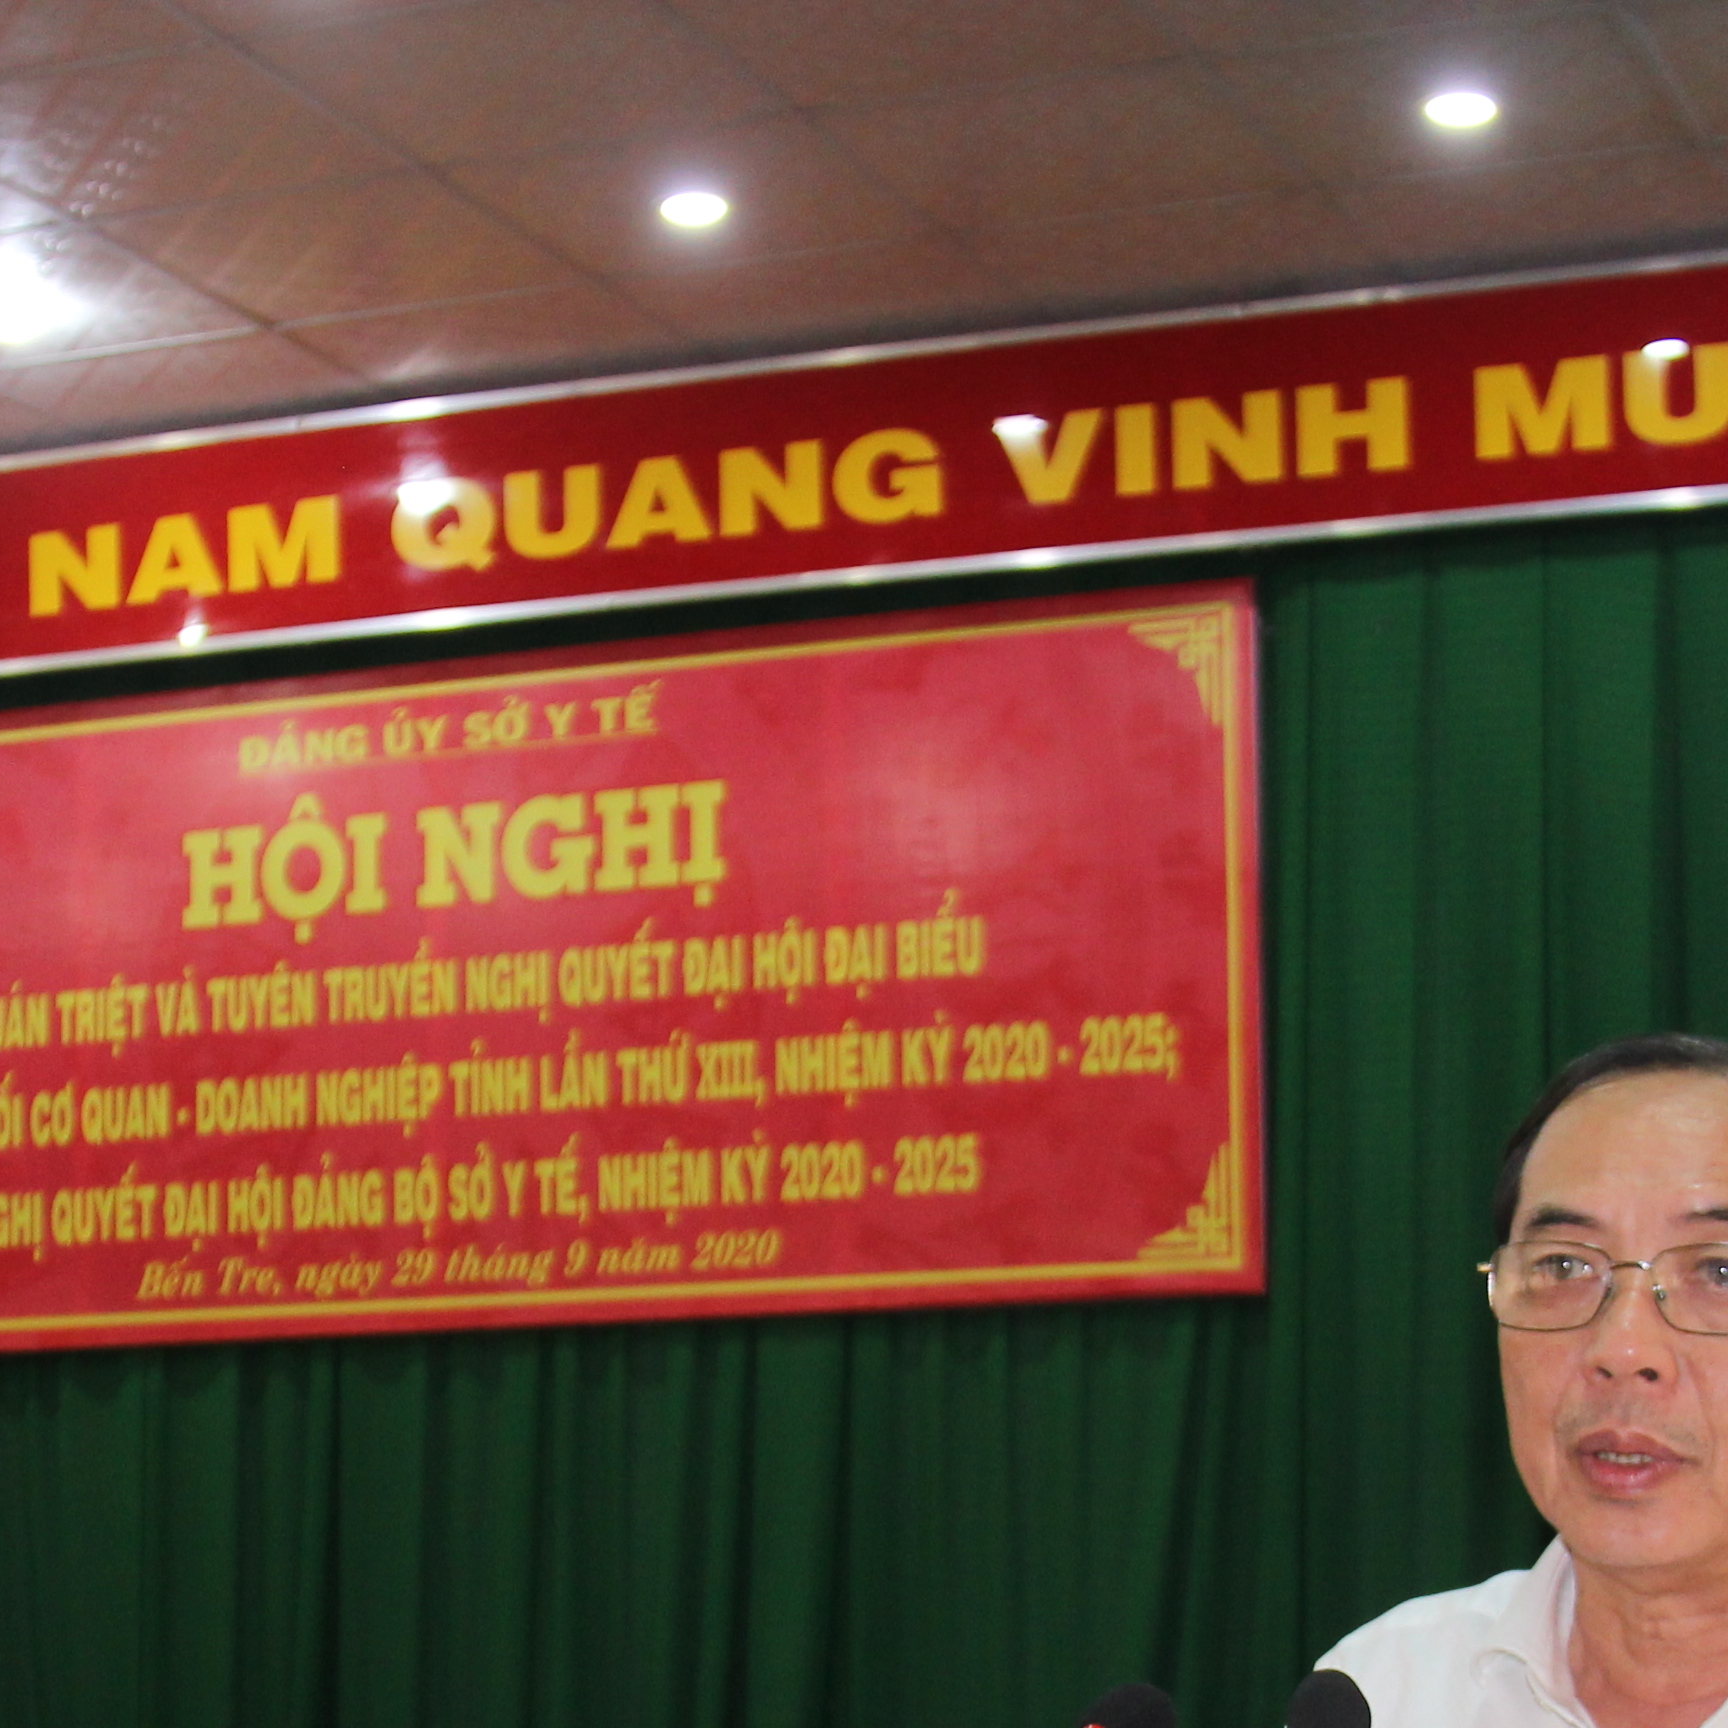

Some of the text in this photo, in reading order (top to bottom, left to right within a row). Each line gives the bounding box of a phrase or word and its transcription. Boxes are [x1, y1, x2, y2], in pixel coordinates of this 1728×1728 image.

[29, 492, 341, 617] NAM
[390, 427, 943, 571] QUANG
[992, 375, 1410, 507] VINH
[238, 679, 662, 777] ĐẢNG ỦY SỞ Y TẾ
[181, 777, 727, 945] HỘI NGHỊ
[55, 972, 151, 1058] TRIỆT
[205, 958, 317, 1035] TUYÊN
[465, 949, 552, 1024] NGHỊ
[558, 916, 677, 1007] QUYẾT
[683, 933, 746, 1011] ĐẠI
[752, 915, 819, 1006] HỘI
[824, 922, 888, 1001] ĐẠI
[896, 886, 986, 982] BIỂU
[30, 1080, 73, 1148] CƠ
[80, 1082, 170, 1146] QUAN
[194, 1071, 308, 1136] DOANH
[315, 1051, 441, 1138] NGHIỆP
[449, 1035, 533, 1116] TỈNH
[616, 1026, 691, 1109] THỨ
[776, 1017, 893, 1109] NHIỆM
[962, 1019, 1049, 1084] 2020
[50, 1161, 157, 1248] QUYẾT
[164, 1177, 219, 1253] ĐẠI
[227, 1163, 286, 1251] HỘI
[291, 1151, 385, 1231] ĐẢNG
[393, 1152, 441, 1241] BỘ
[448, 1141, 493, 1222] SỞ
[502, 1160, 526, 1217] Y
[533, 1131, 590, 1225] TẾ,
[597, 1136, 712, 1226] NHIỆM
[779, 1138, 865, 1204] 2020
[893, 1131, 980, 1197] 2025
[137, 1227, 784, 1299] Bến Tre, ngày 29 tháng 9 năm 2020
